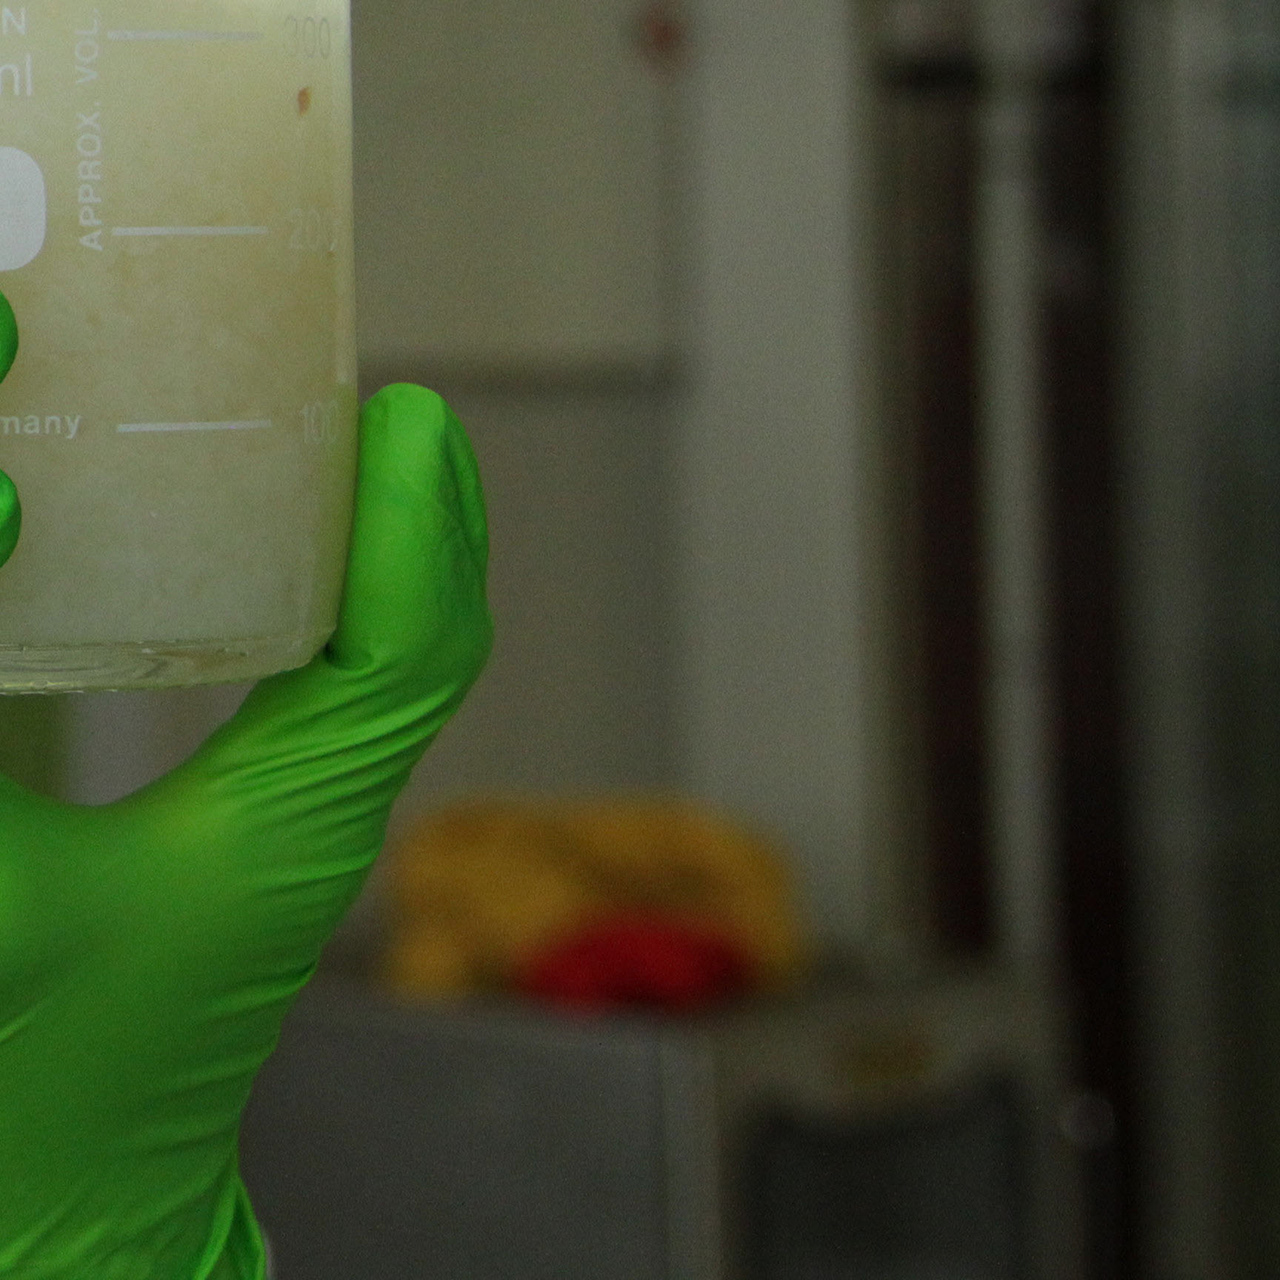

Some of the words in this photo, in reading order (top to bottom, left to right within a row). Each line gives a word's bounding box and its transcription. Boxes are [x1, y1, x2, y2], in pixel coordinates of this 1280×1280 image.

[283, 15, 331, 60] 300
[76, 101, 103, 251] APPROX.
[298, 399, 338, 444] 100
